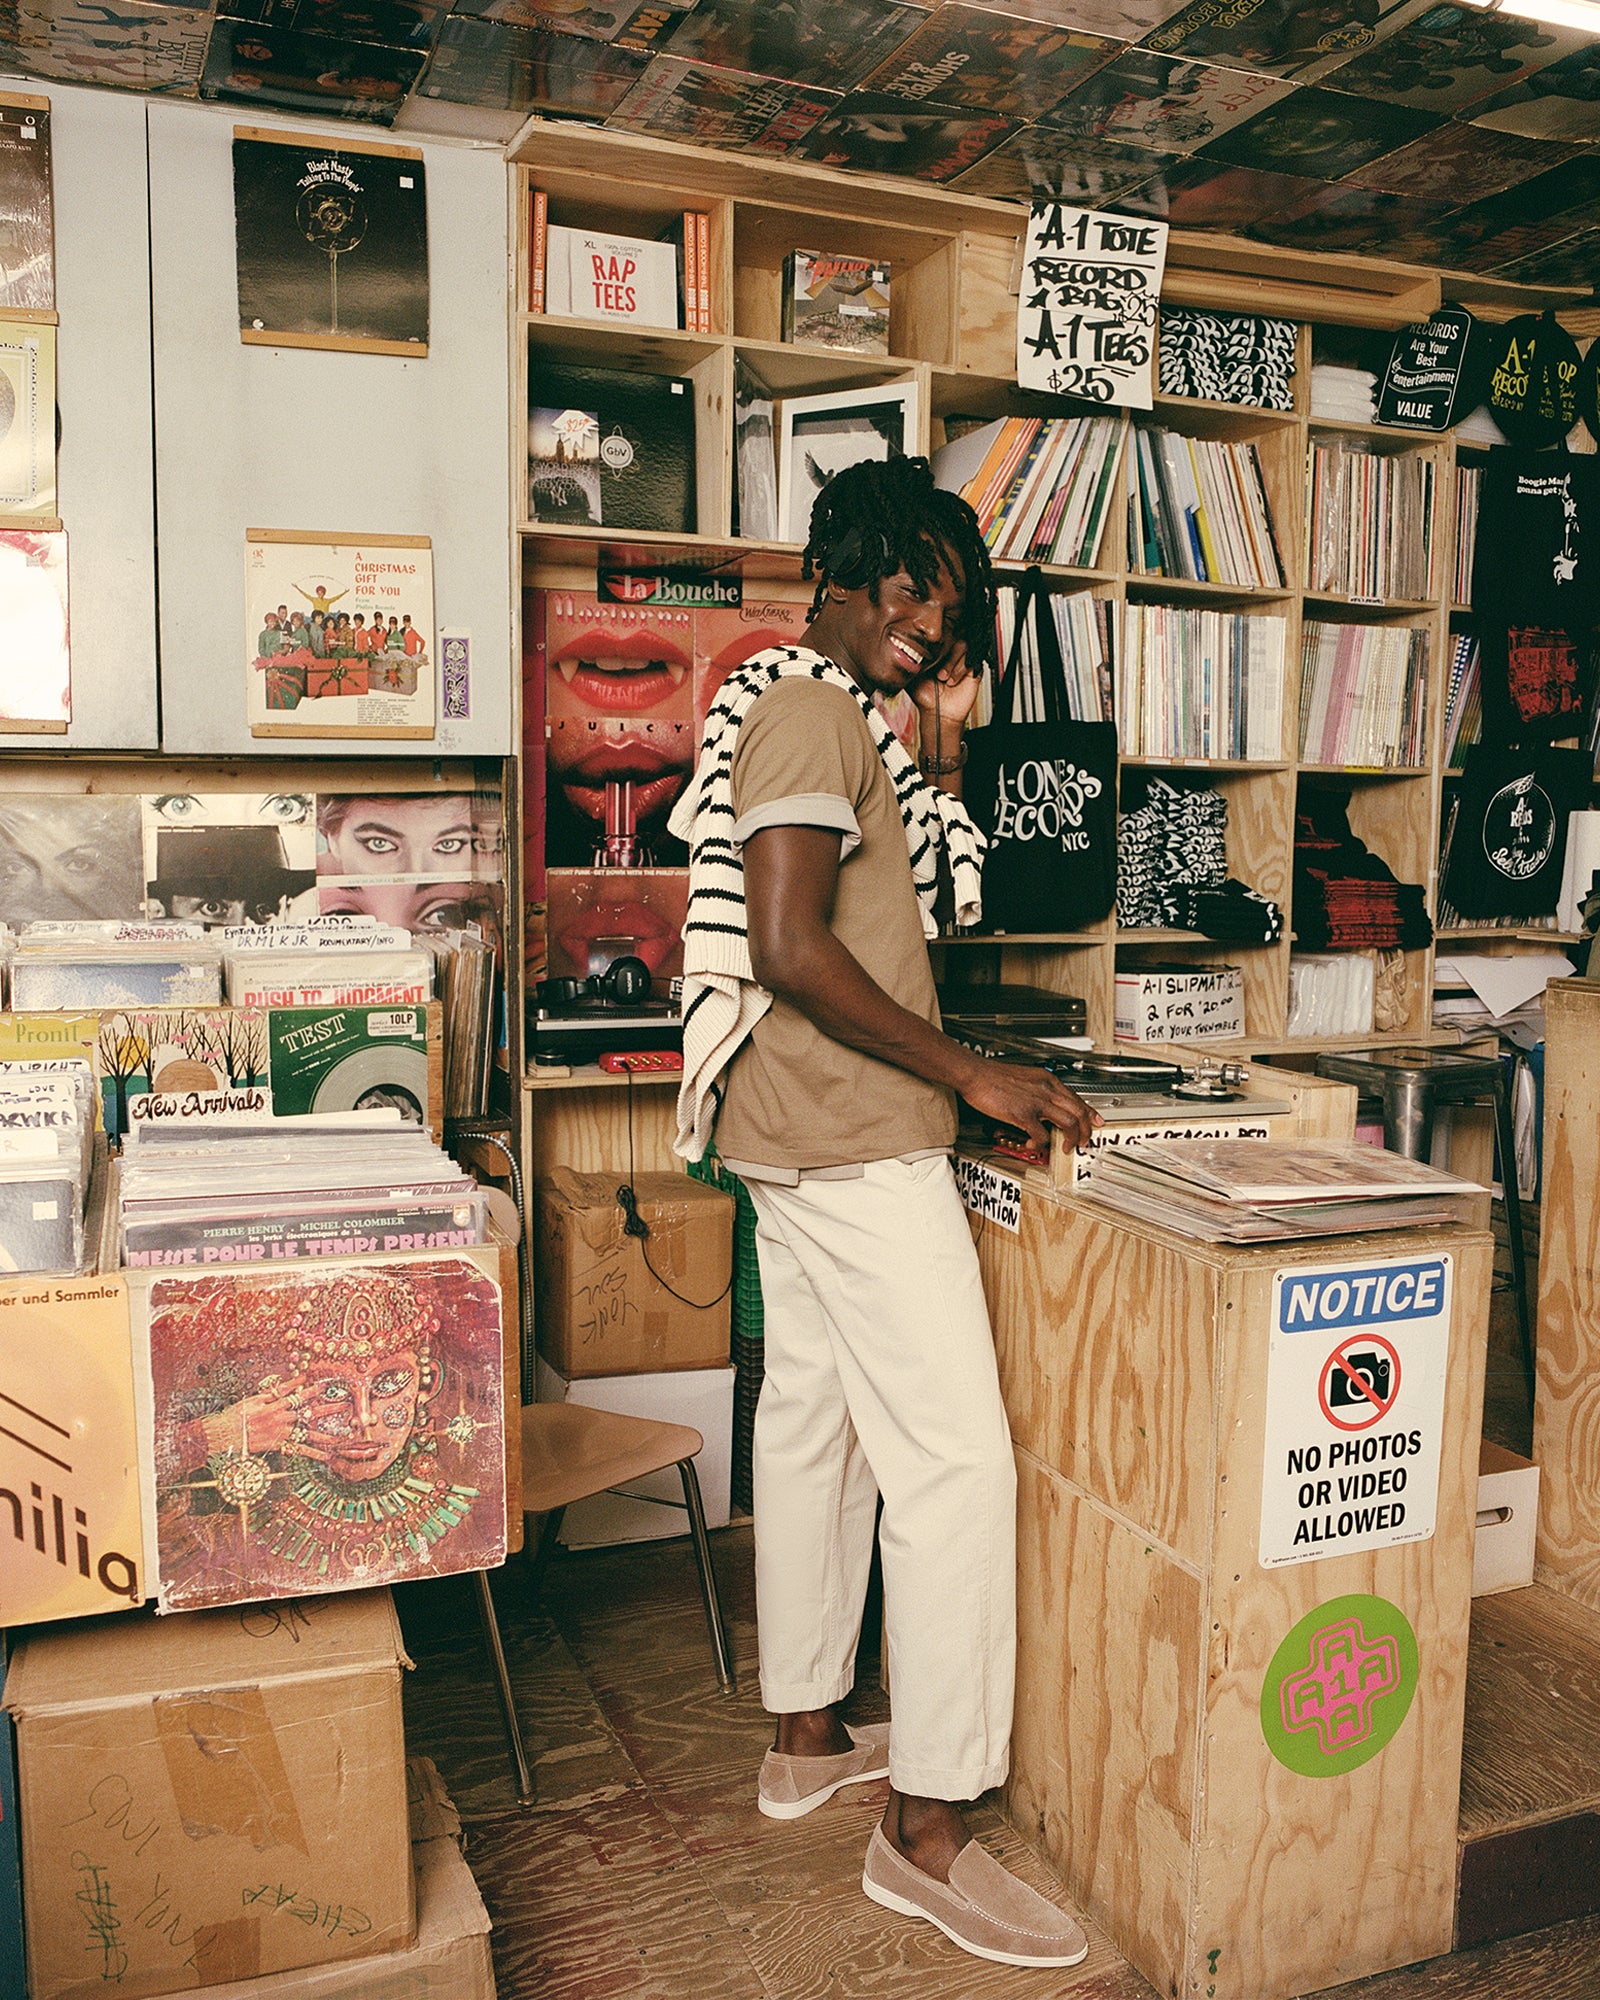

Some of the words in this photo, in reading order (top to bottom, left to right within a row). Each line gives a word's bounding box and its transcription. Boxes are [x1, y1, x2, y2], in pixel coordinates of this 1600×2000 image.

[897, 49, 974, 101] SHOWBIZ
[306, 159, 329, 174] Black
[331, 160, 354, 178] Nasty
[322, 172, 330, 182] To
[331, 172, 341, 182] The
[1035, 204, 1089, 250] A-1
[1093, 220, 1160, 255] TOTE
[584, 240, 597, 249] XL
[591, 254, 636, 283] RAP
[1027, 258, 1147, 291] RECORD
[592, 281, 636, 312] TEES
[1055, 284, 1124, 310] BAG
[1024, 310, 1083, 360] A-1
[1410, 338, 1426, 353] Are
[1429, 341, 1449, 356] Your
[1416, 354, 1438, 367] Best
[1047, 364, 1115, 402] $25
[1393, 372, 1456, 388] entertainment
[1491, 367, 1529, 397] RECO
[1396, 401, 1434, 419] VALUE
[1517, 486, 1542, 495] gonna
[1543, 486, 1558, 496] get
[1518, 476, 1547, 487] Boogie
[355, 552, 363, 561] A
[354, 562, 417, 575] CHRISTMAS
[354, 573, 378, 584] GIFT
[355, 585, 376, 596] FOR
[380, 586, 401, 597] YOU
[623, 575, 648, 599] La
[654, 576, 739, 603] Bouche
[558, 721, 684, 733] JUICY
[1062, 831, 1090, 853] NYC
[390, 1013, 413, 1025] 10LP
[1147, 1004, 1159, 1021] 2
[1166, 1002, 1194, 1019] FOR
[15, 1023, 81, 1044] Pronit
[279, 1013, 346, 1053] TEST
[1146, 1026, 1164, 1040] FOR
[1170, 1024, 1192, 1039] YOUR
[1194, 1019, 1239, 1034] TURNTABLE
[29, 1085, 55, 1093] LOVE
[133, 1094, 176, 1120] New
[182, 1089, 264, 1117] Arrivals
[1000, 1179, 1021, 1205] PER
[971, 1188, 1018, 1227] STATION
[203, 1226, 245, 1238] PIERRE
[247, 1223, 285, 1236] HENRY
[300, 1221, 341, 1233] MICHEL
[343, 1217, 405, 1231] COLOMBIER
[248, 1234, 260, 1243] les
[262, 1232, 283, 1244] jerks
[340, 1228, 351, 1238] de
[352, 1227, 362, 1236] la
[128, 1248, 197, 1268] MESSE
[203, 1243, 264, 1264] POUR
[272, 1240, 299, 1260] LE
[304, 1236, 378, 1257] TEMPS
[383, 1230, 476, 1252] PRESENT
[22, 1291, 50, 1304] und
[55, 1286, 120, 1302] Sammler
[1286, 1268, 1441, 1325] NOTICE
[1287, 1445, 1322, 1476] NO
[1328, 1430, 1422, 1469] PHOTOS
[1298, 1480, 1332, 1509] OR
[1338, 1467, 1408, 1502] VIDEO
[1293, 1503, 1406, 1546] ALLOWED
